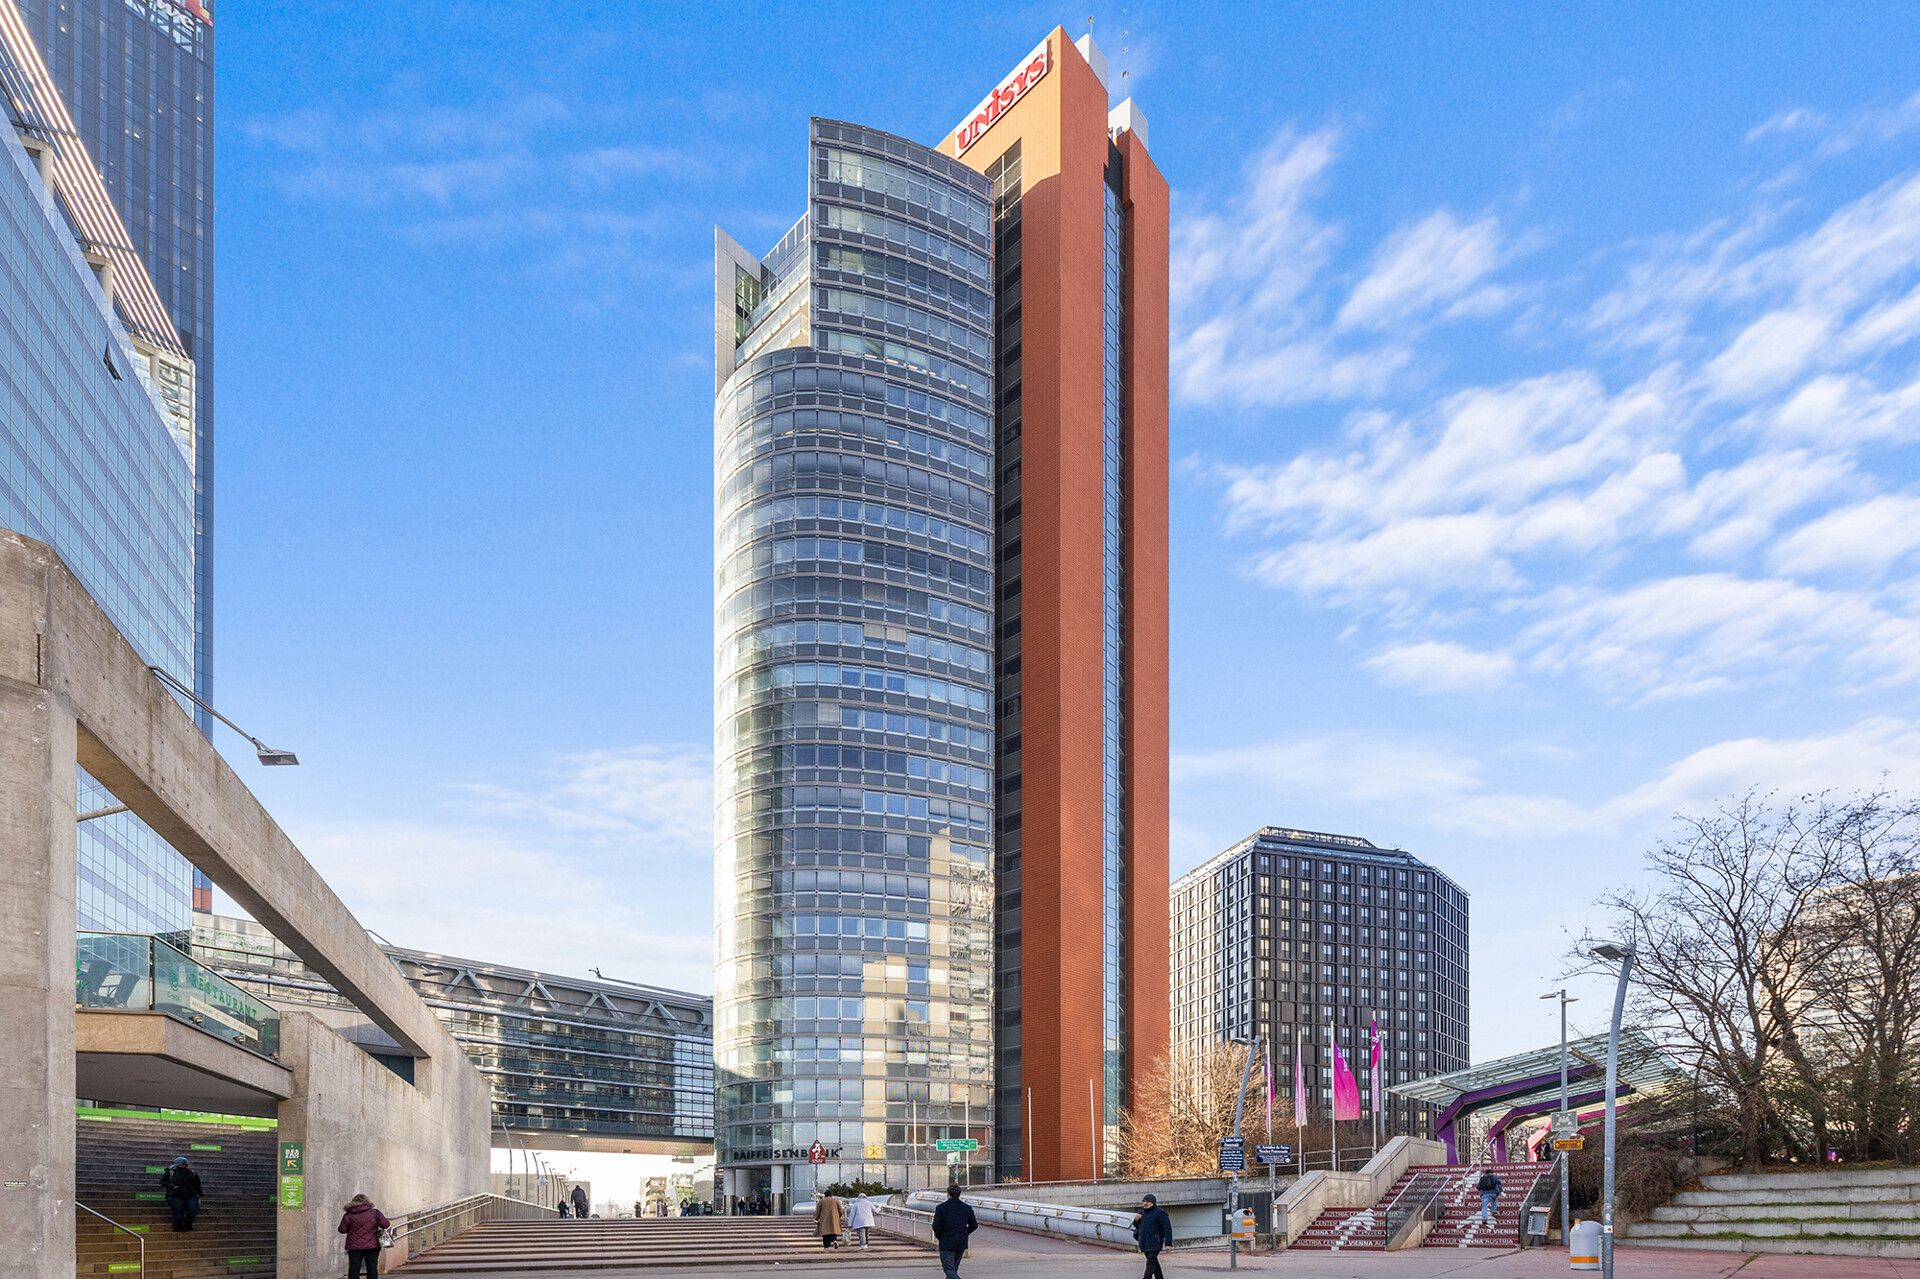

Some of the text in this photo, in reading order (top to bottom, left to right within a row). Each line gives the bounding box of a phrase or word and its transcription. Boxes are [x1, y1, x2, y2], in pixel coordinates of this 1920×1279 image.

[733, 1149, 840, 1161] RAIFFEISENBK
[1297, 1238, 1321, 1246] AUSTRIA
[1349, 1238, 1373, 1246] VIENNA
